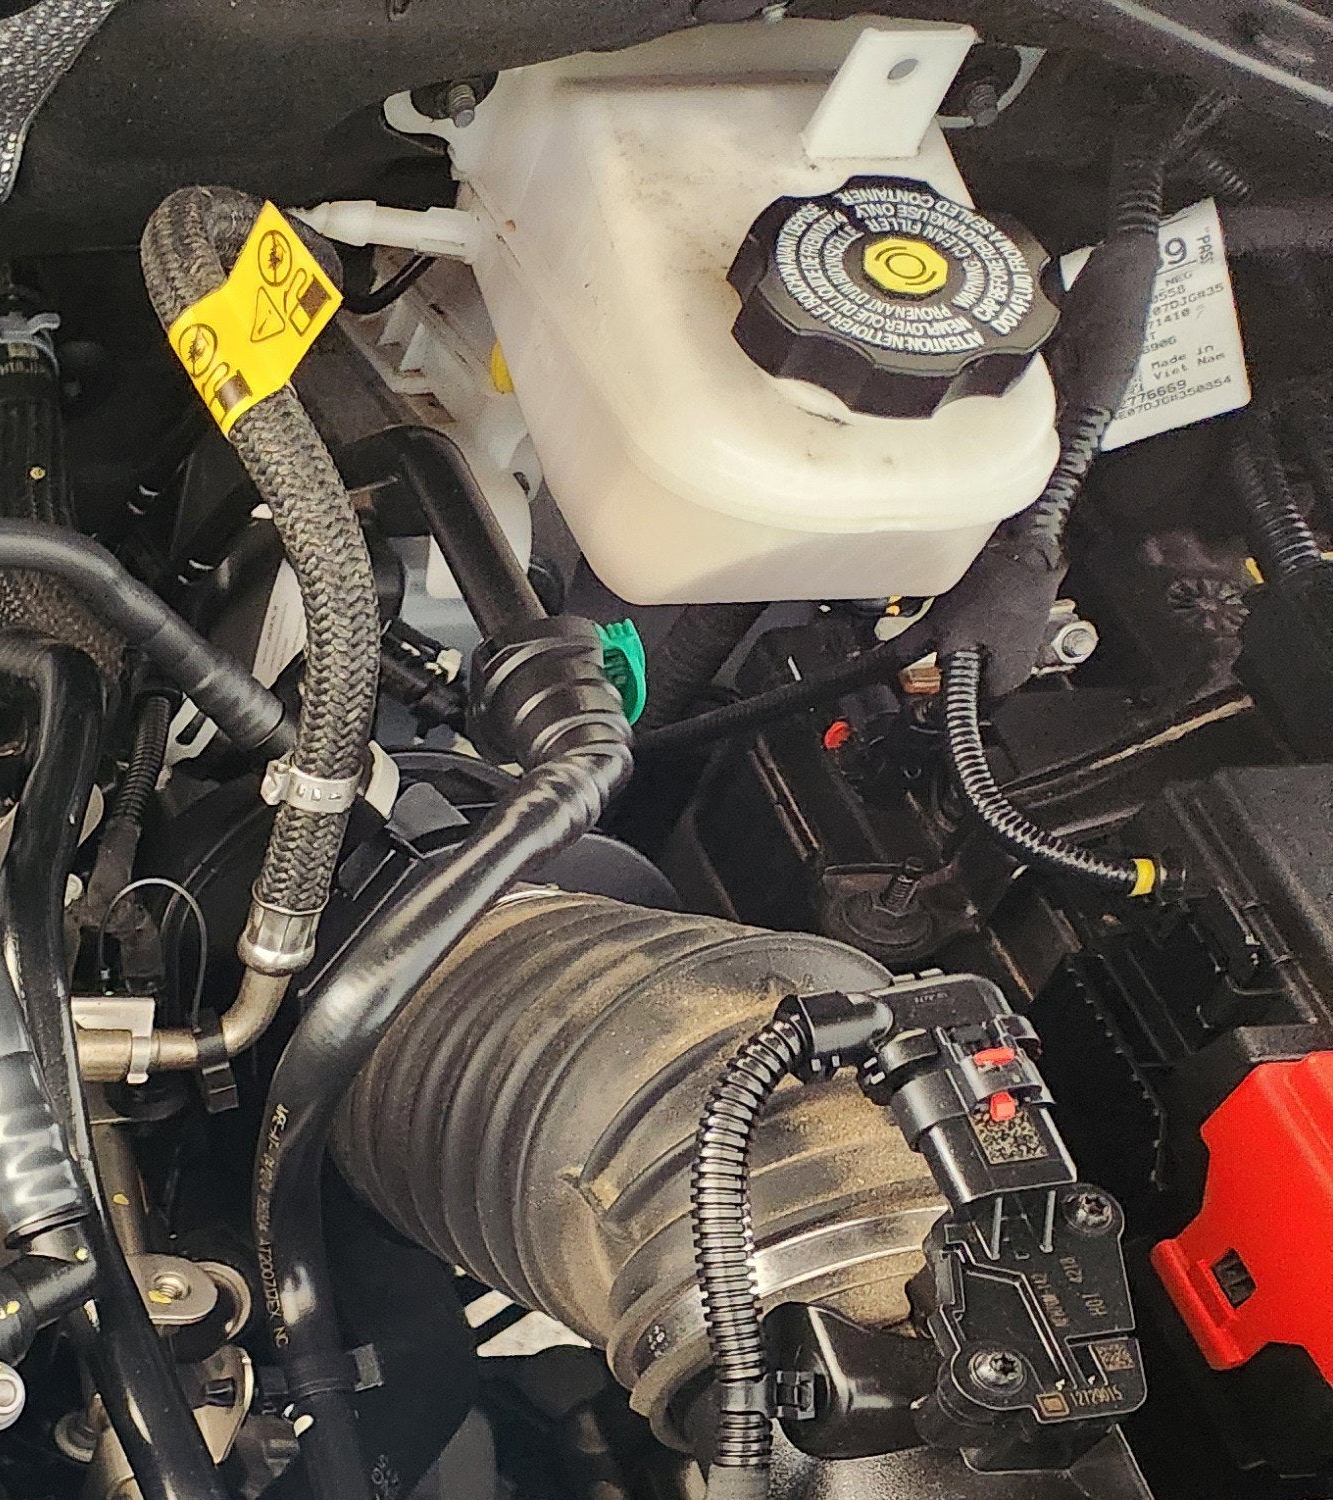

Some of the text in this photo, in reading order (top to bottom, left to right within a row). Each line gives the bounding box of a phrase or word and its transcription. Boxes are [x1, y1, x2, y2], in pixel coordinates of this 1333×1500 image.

[854, 202, 894, 218] ONLY
[897, 204, 929, 221] USE
[935, 200, 995, 234] SEALED
[865, 217, 921, 234] FILLER
[923, 225, 971, 257] CLEAN
[1158, 237, 1188, 266] 9
[995, 240, 1029, 272] FROM
[985, 259, 1008, 301] BEFORE
[1010, 274, 1033, 306] FLUID
[810, 303, 835, 320] LE
[865, 299, 951, 320] PROVENANT
[972, 297, 999, 321] CAP
[990, 308, 1021, 333] DOT
[830, 314, 903, 348] NETTOYER
[1151, 345, 1215, 370] Made in
[1154, 353, 1226, 381] Viet Nam
